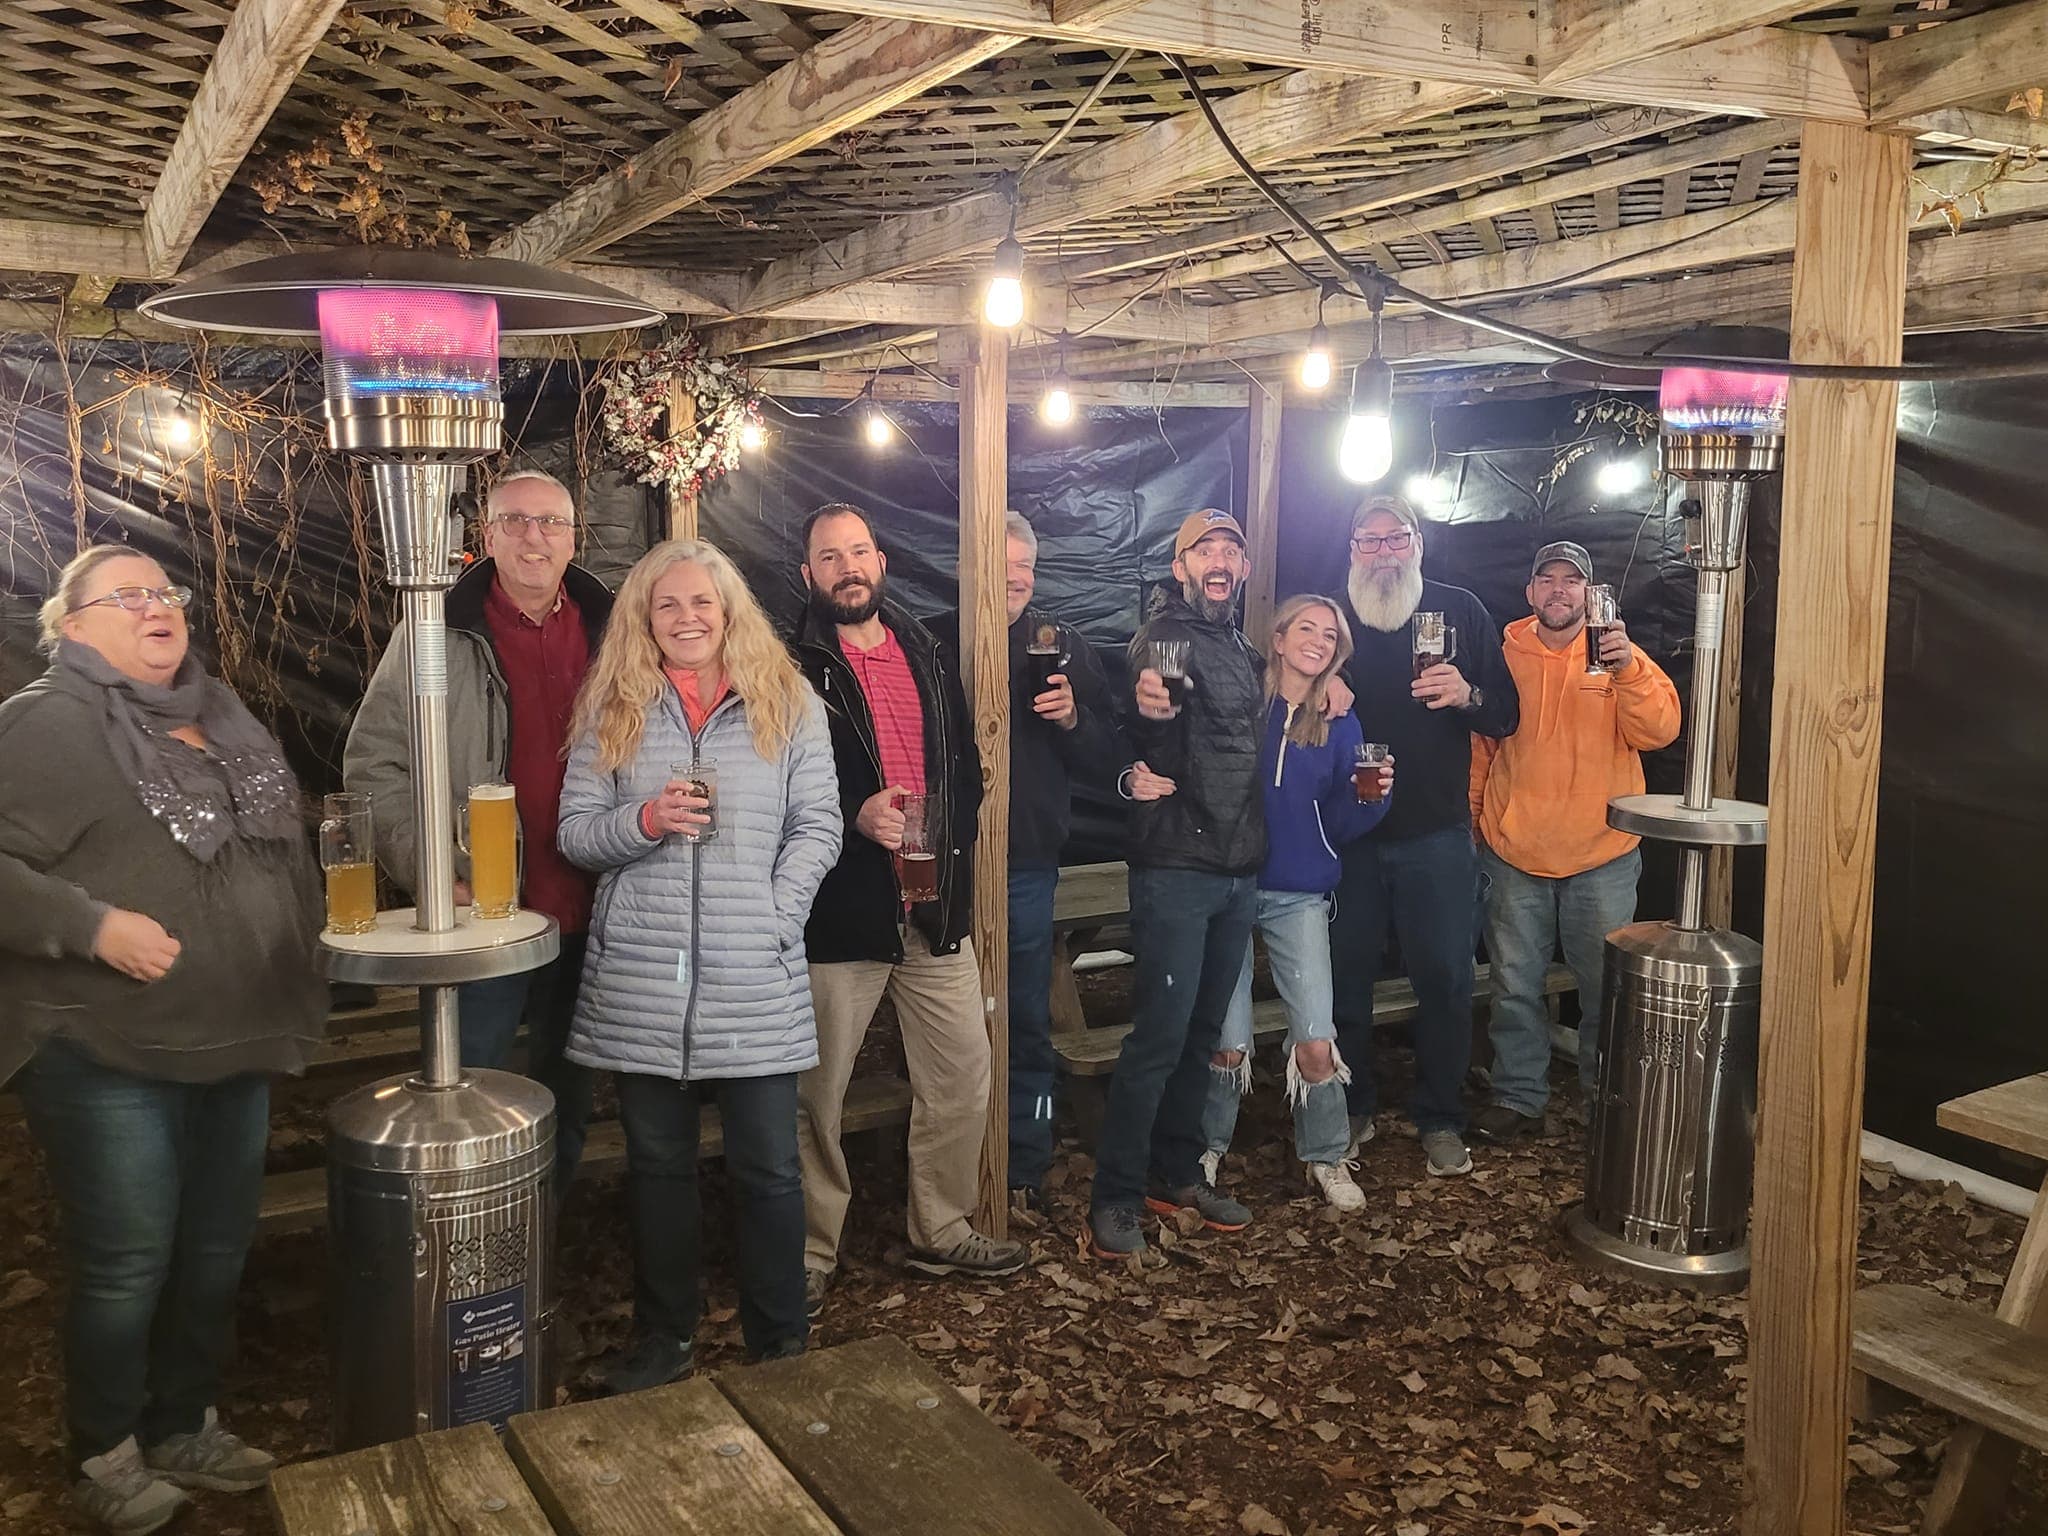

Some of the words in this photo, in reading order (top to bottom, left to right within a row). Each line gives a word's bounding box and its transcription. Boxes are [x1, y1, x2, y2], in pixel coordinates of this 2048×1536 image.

[455, 1337, 472, 1346] Gas
[473, 1330, 495, 1342] Patio
[495, 1320, 521, 1336] Heater
